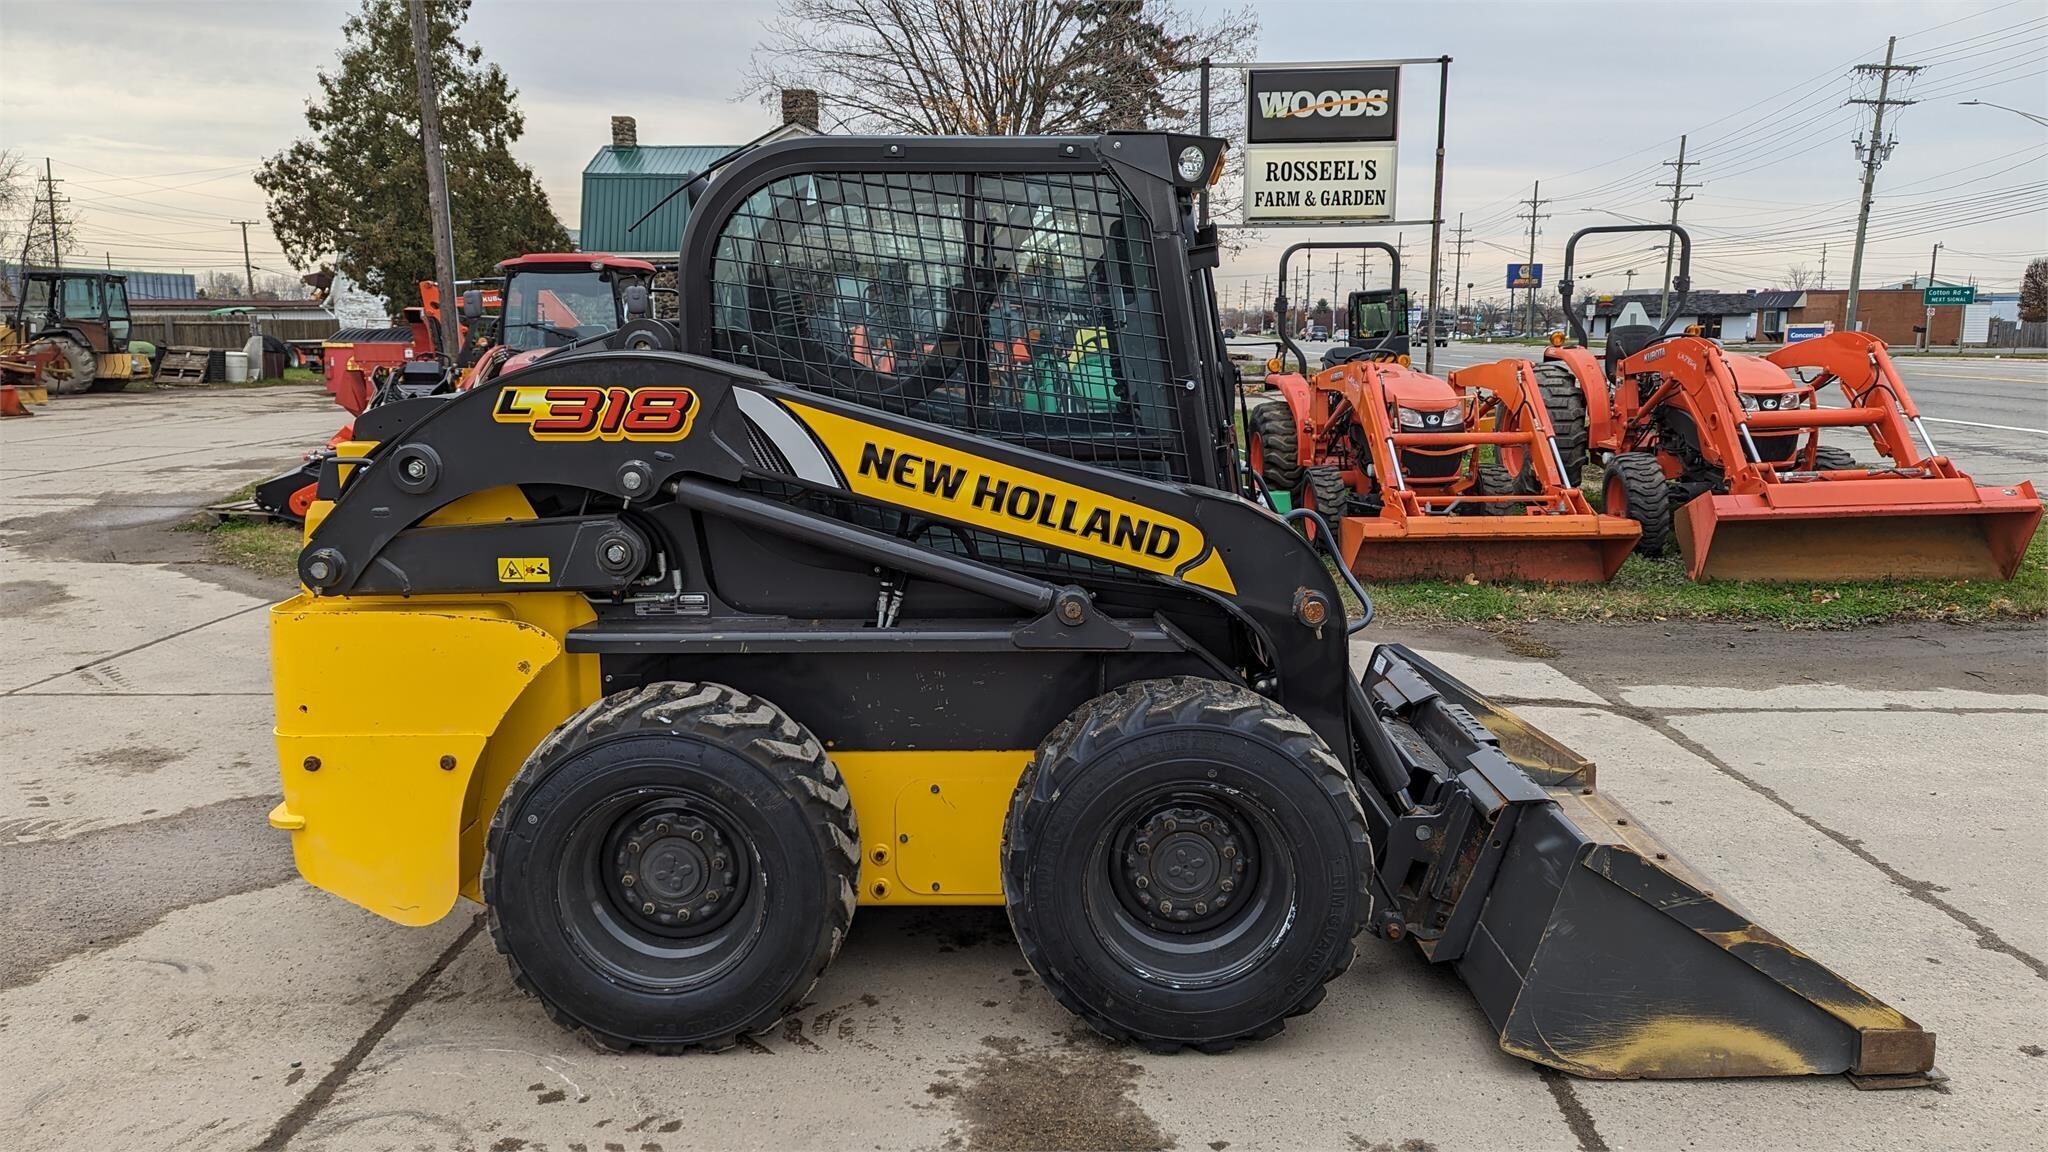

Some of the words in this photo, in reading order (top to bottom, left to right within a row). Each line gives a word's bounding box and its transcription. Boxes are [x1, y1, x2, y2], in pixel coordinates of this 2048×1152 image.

[1258, 89, 1389, 117] WOODS
[1265, 159, 1377, 182] ROSSEEL'S
[1254, 190, 1300, 207] FARM
[1304, 190, 1317, 207] &
[1320, 189, 1386, 206] GARDEN
[496, 388, 696, 436] L318
[857, 441, 968, 500] NEW
[970, 474, 1182, 560] HOLLAND
